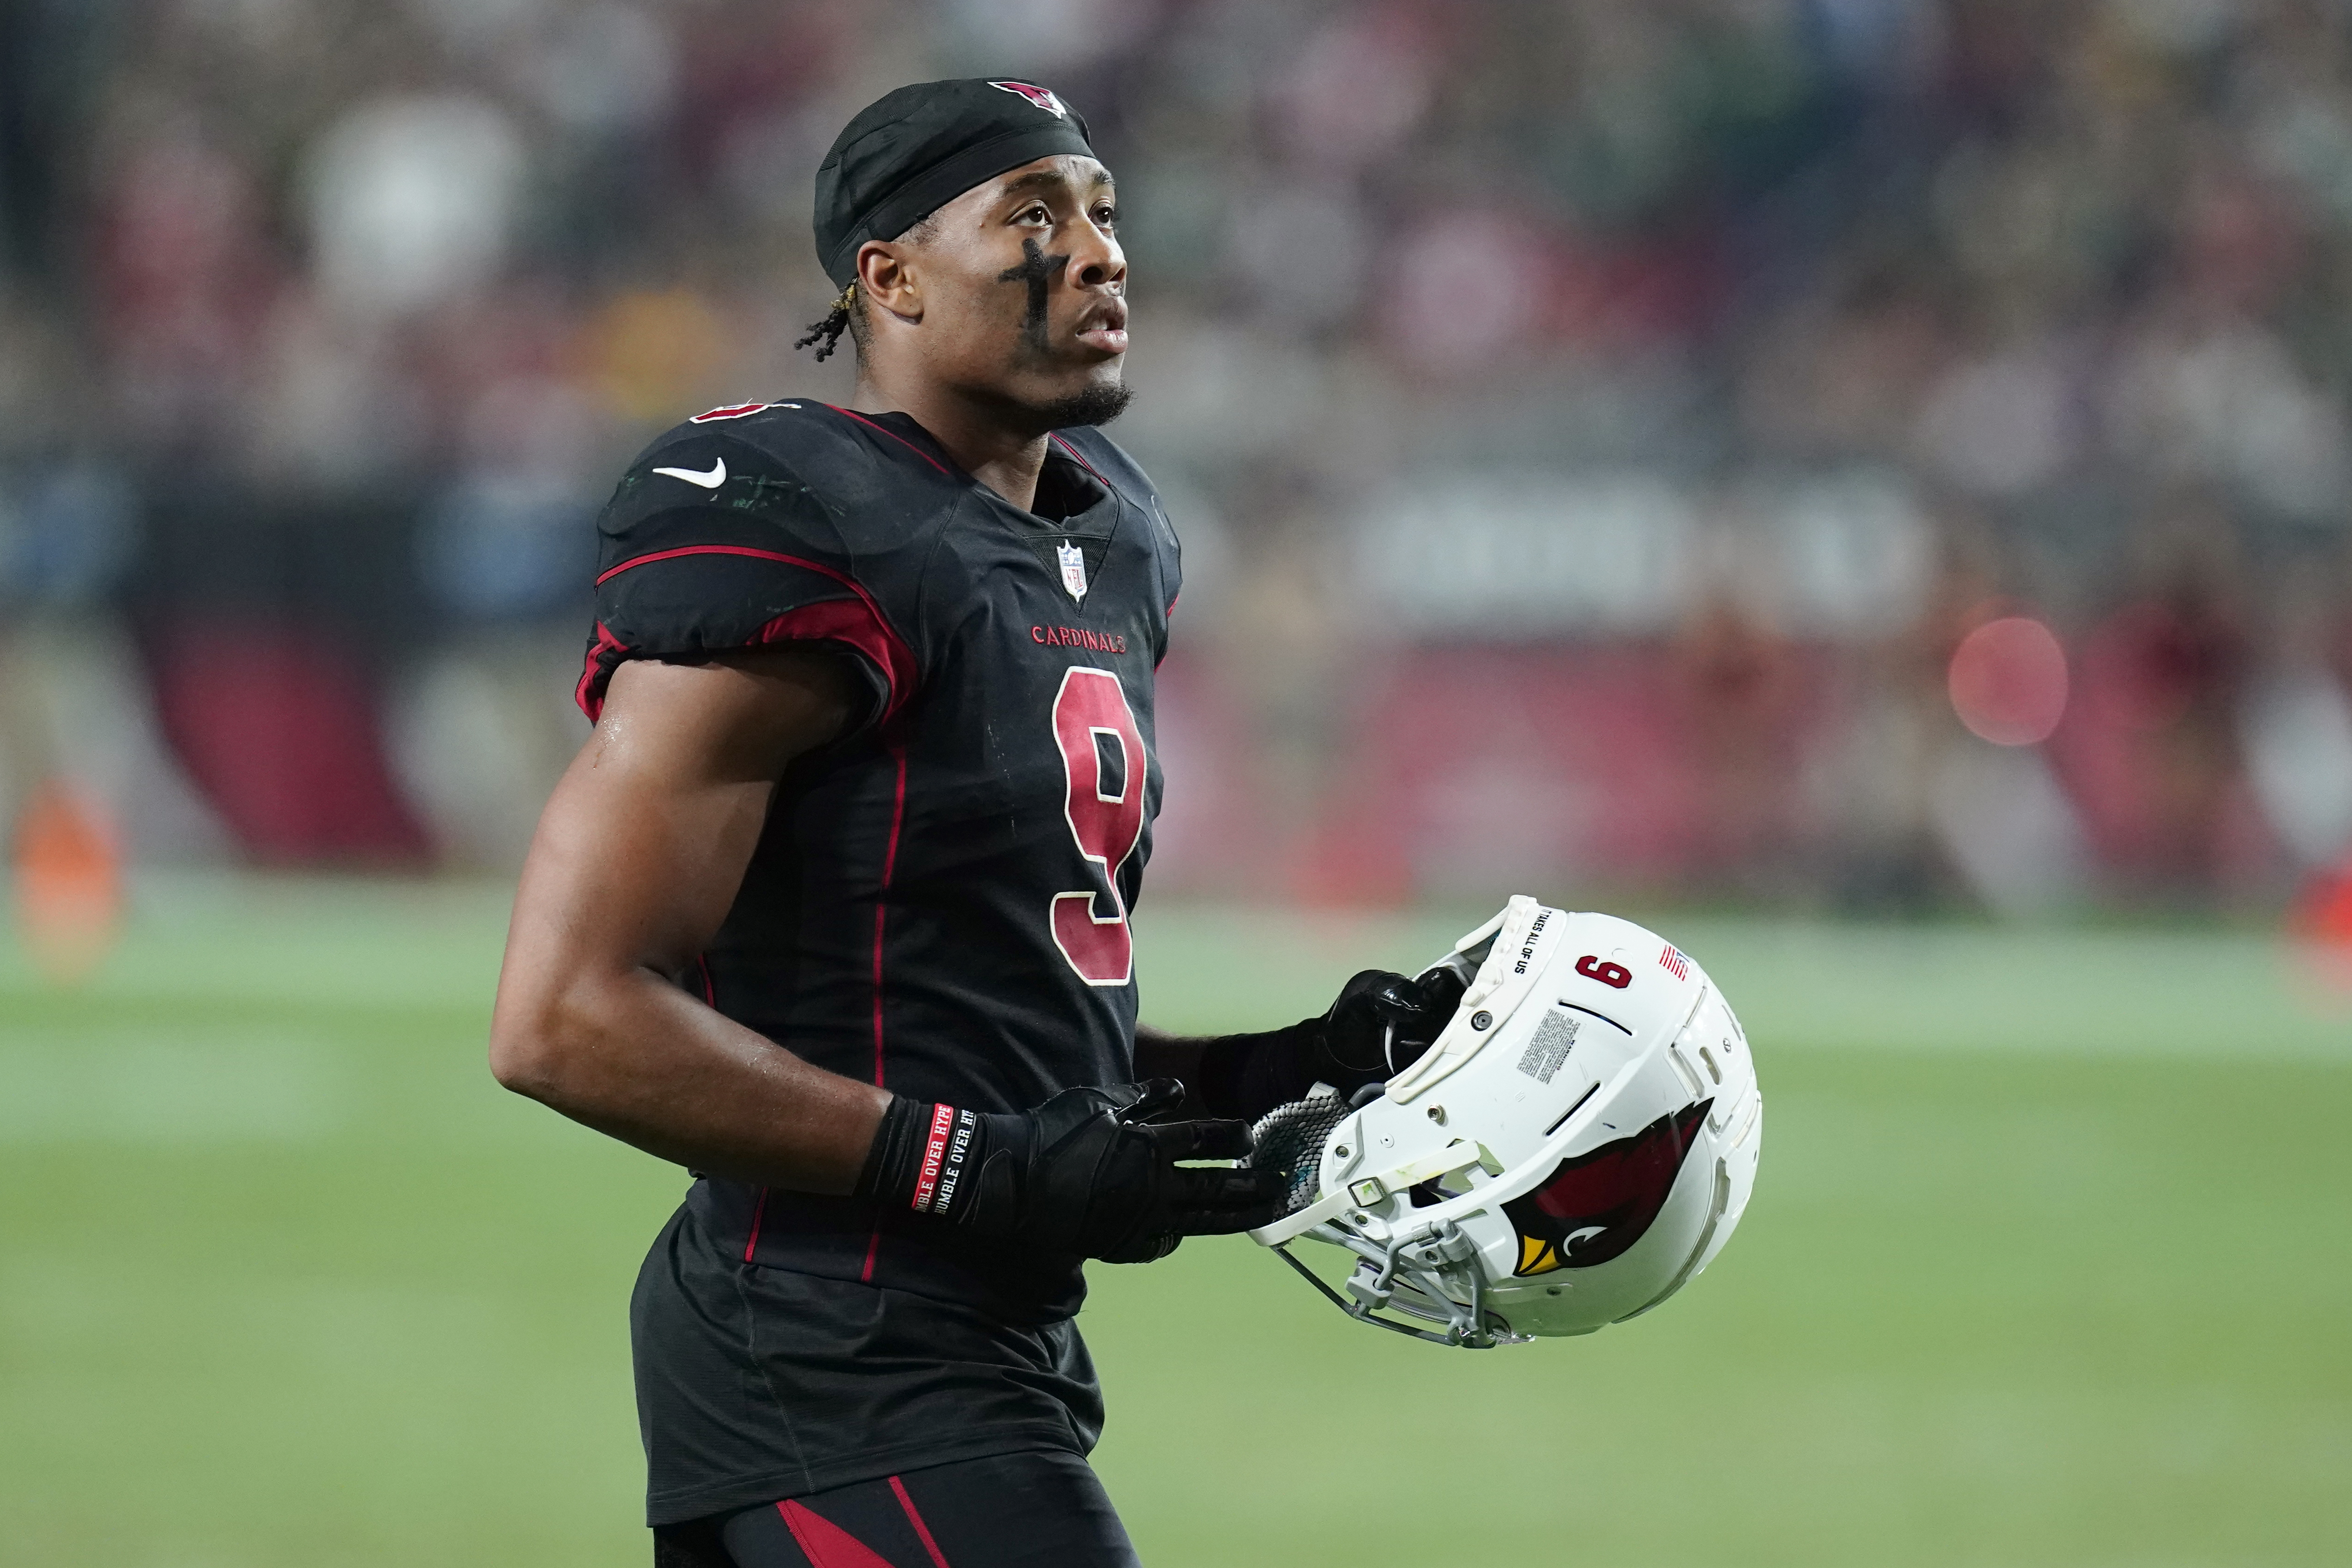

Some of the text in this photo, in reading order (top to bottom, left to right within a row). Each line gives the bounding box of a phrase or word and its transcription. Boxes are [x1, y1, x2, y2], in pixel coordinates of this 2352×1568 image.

[1065, 569, 1083, 589] NFL
[1031, 626, 1126, 654] CARDINALS
[1049, 666, 1147, 986] 9
[1532, 913, 1550, 932] TAKES
[1525, 932, 1539, 945] ALL
[1515, 960, 1528, 974] US
[1521, 947, 1533, 960] OF
[1557, 1039, 1576, 1070] WARNING
[934, 1105, 951, 1136] HYPE
[925, 1140, 944, 1177] OVER
[934, 1167, 959, 1215] HUMBLE
[951, 1128, 971, 1163] OVER
